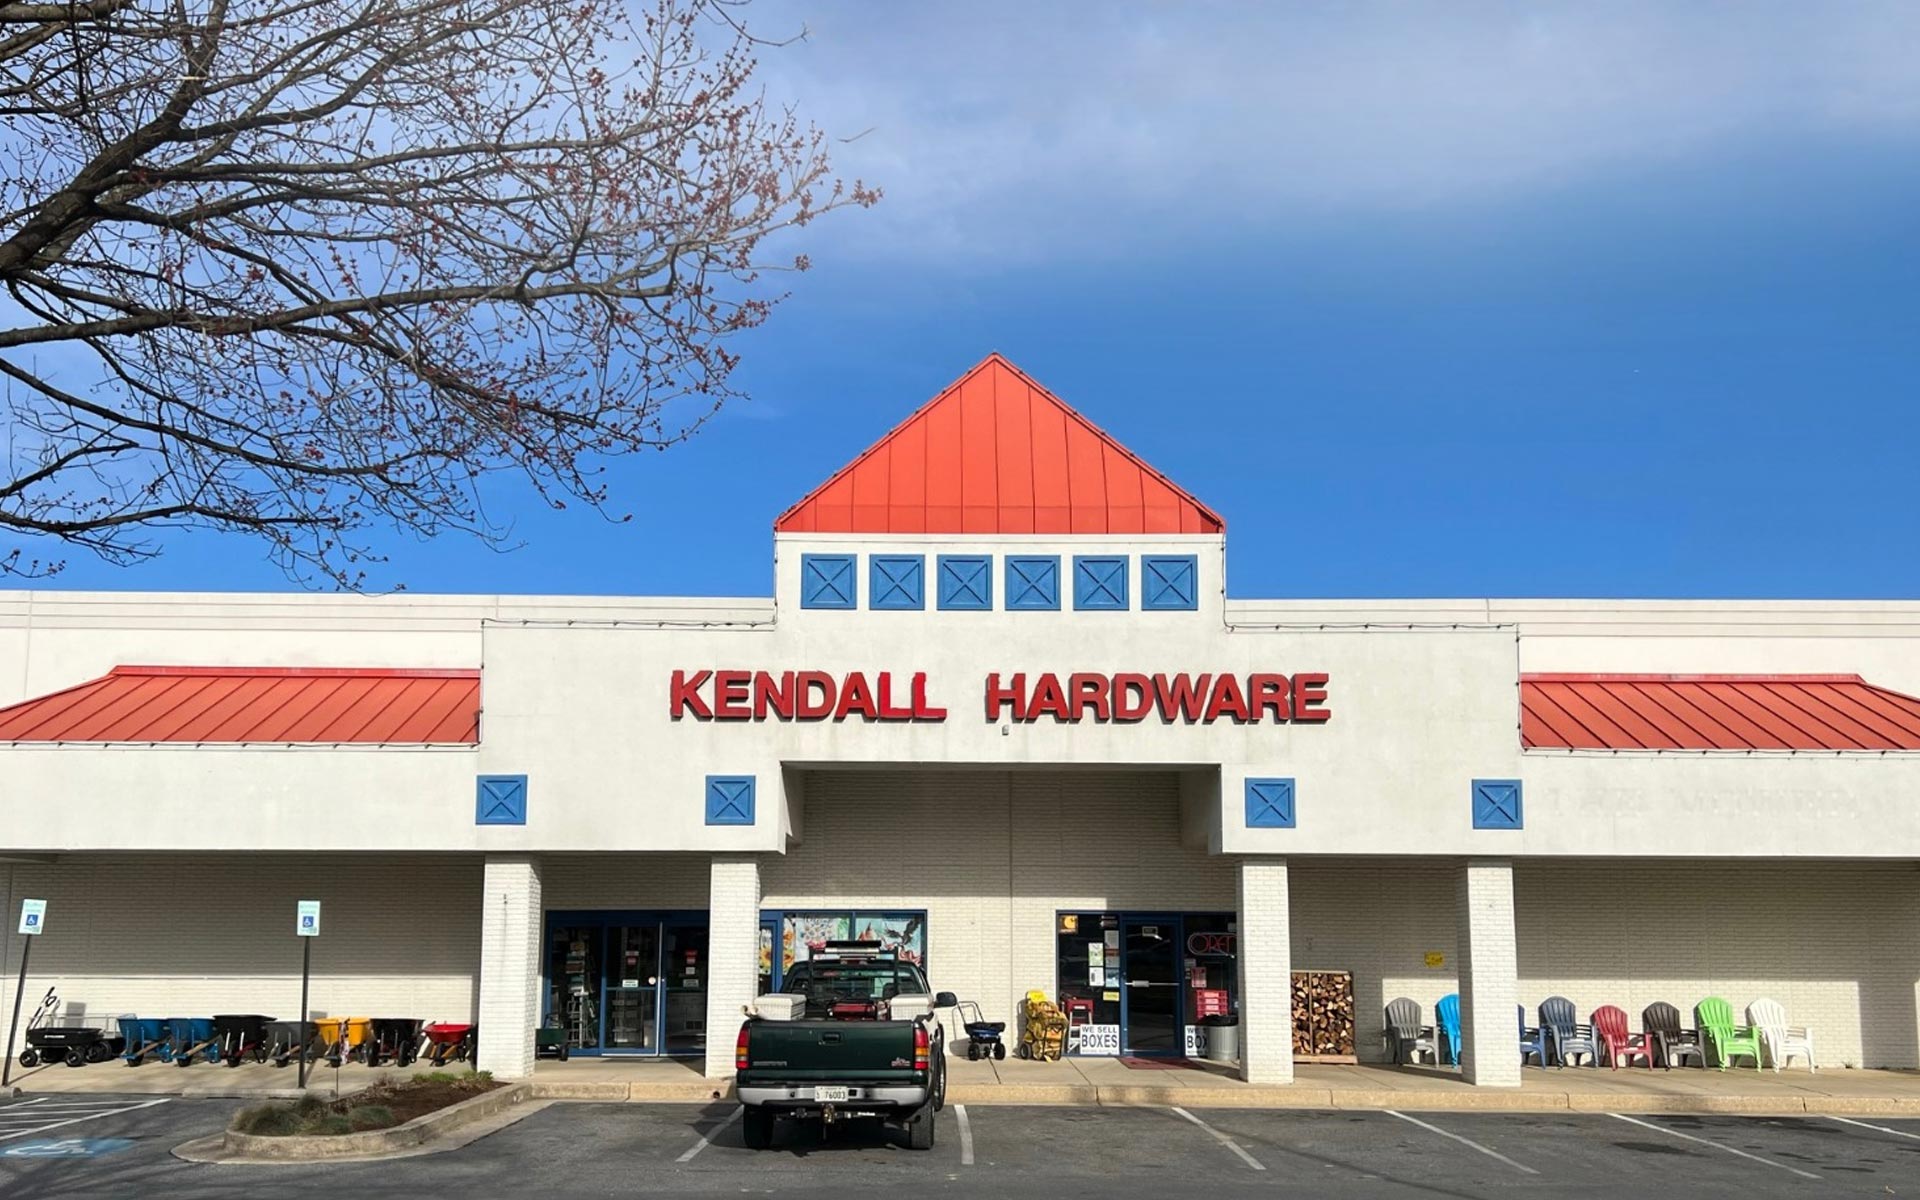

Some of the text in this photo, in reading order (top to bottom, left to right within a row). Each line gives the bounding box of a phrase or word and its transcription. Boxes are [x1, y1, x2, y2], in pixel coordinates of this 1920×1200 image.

[670, 670, 1331, 724] KENDALL HARDWARE
[1081, 1034, 1118, 1048] BOXES
[1186, 1035, 1208, 1049] BOX
